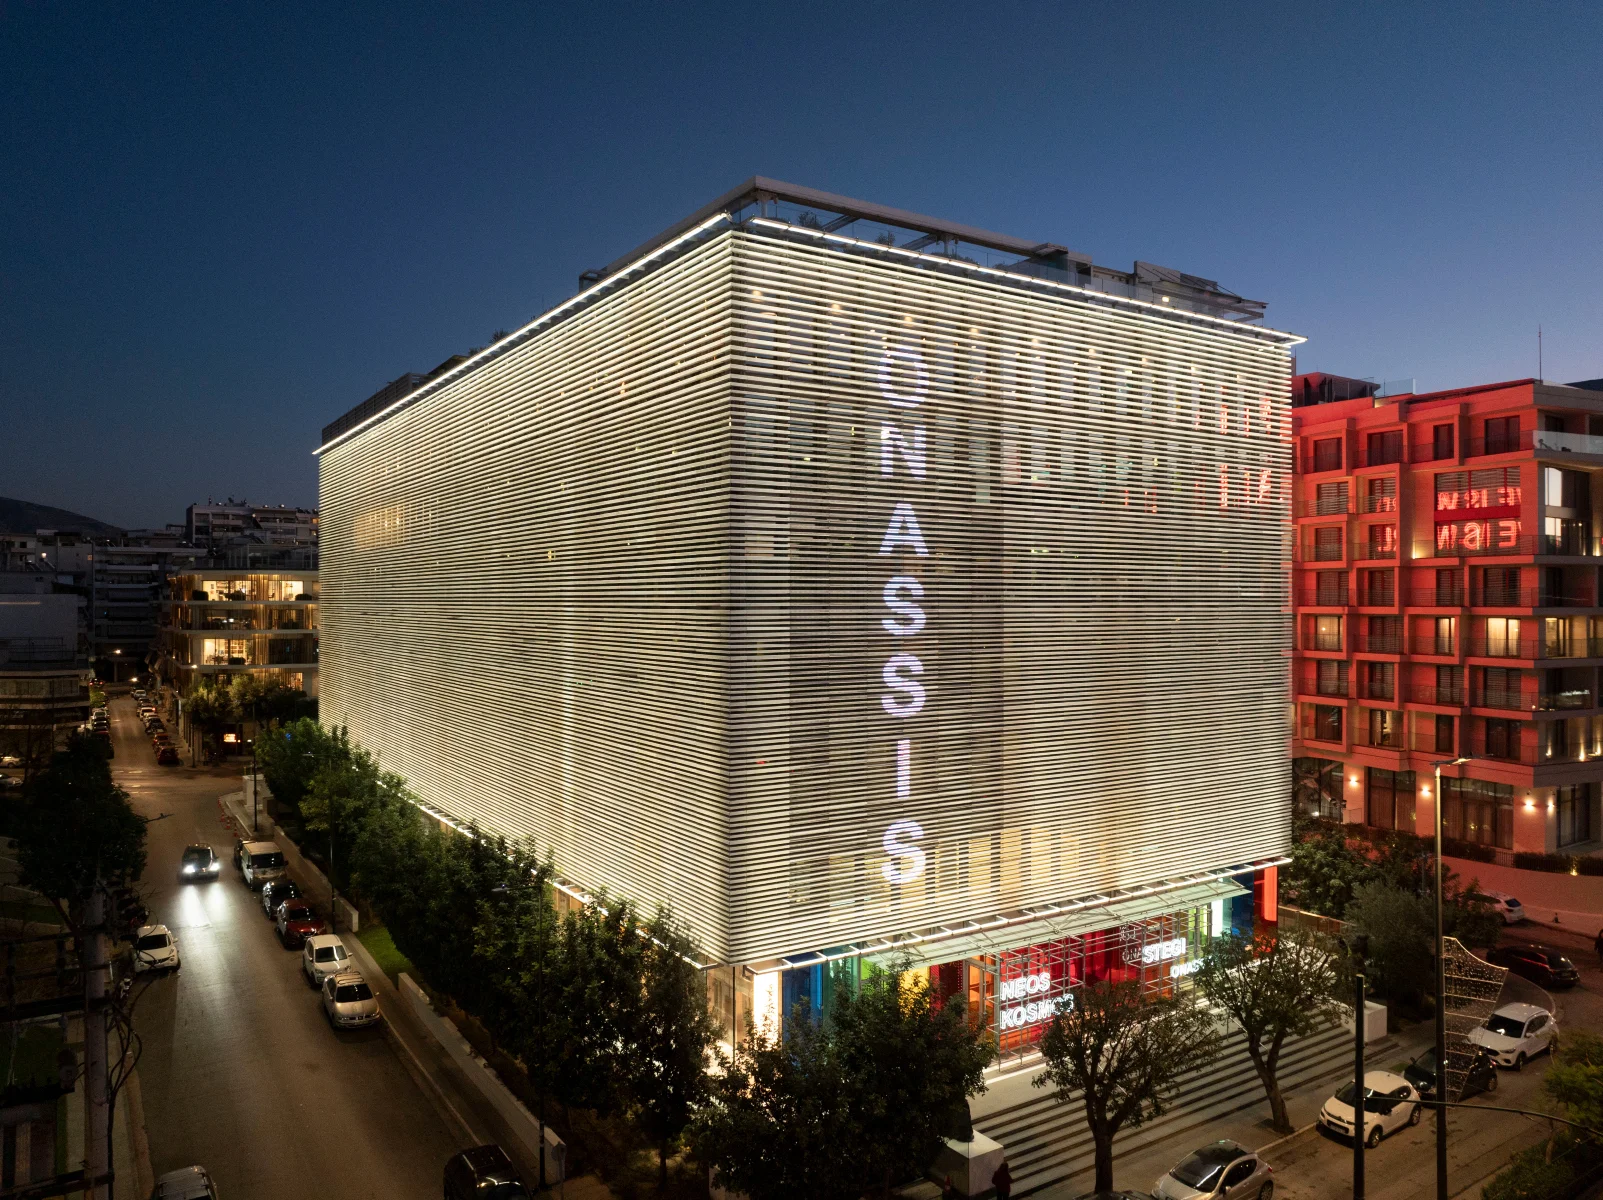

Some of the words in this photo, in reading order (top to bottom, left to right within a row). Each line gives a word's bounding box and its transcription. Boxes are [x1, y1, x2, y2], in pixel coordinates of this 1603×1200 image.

[878, 345, 930, 885] ONASSIS
[1142, 937, 1186, 964] STEGI
[1000, 971, 1051, 1001] NEOS
